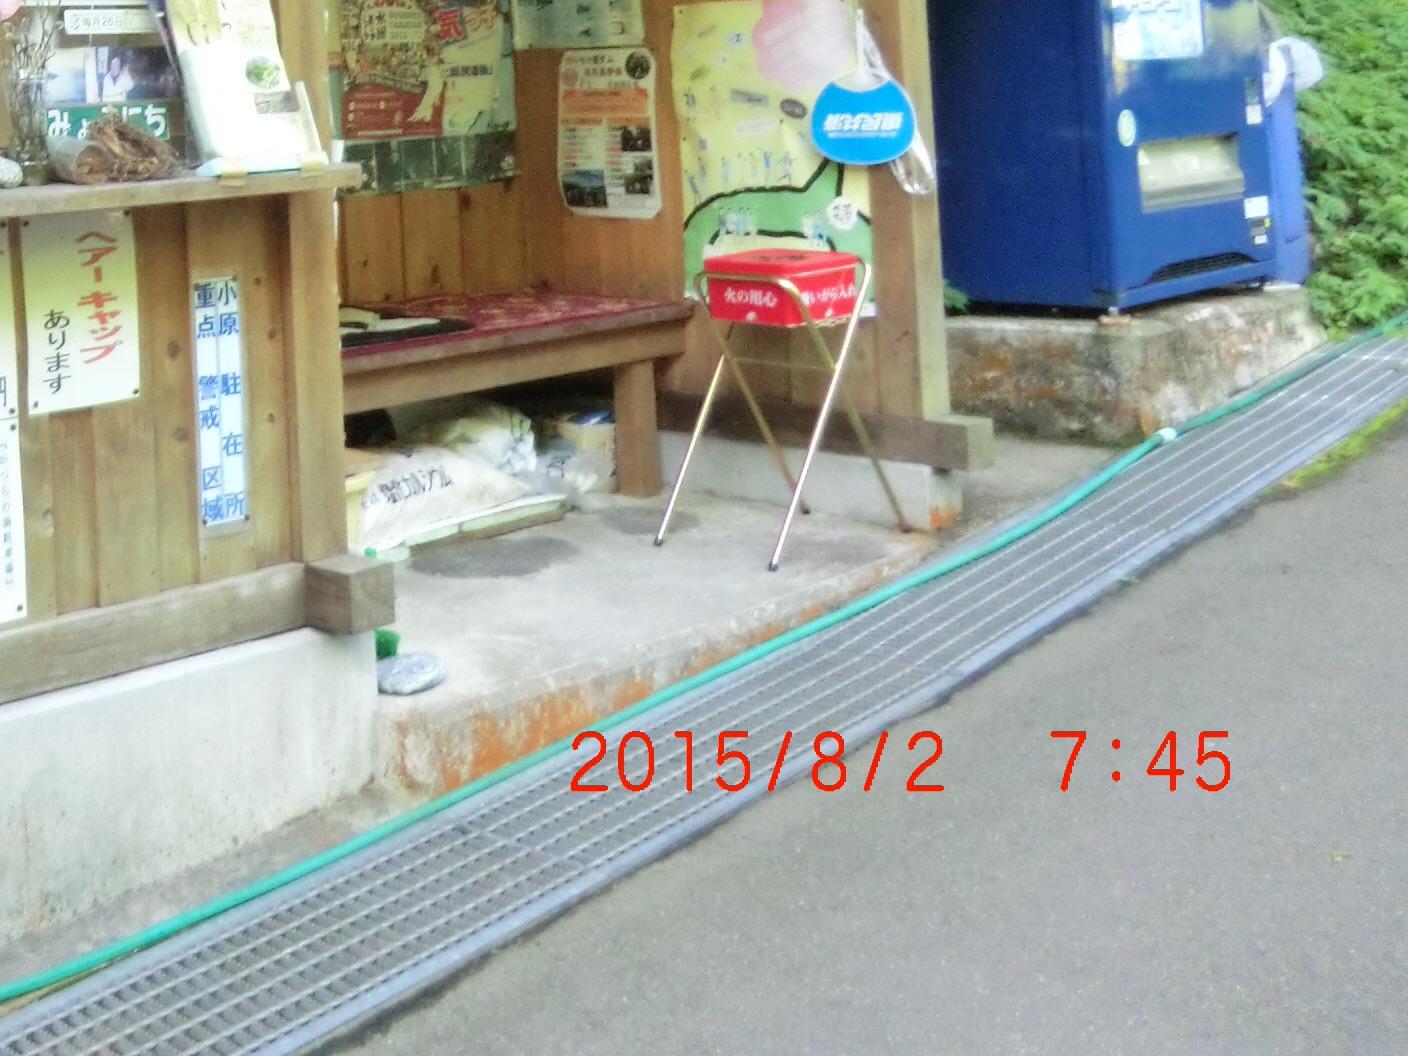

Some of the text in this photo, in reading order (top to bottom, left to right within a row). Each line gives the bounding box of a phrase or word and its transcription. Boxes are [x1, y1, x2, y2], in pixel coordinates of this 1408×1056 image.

[44, 308, 72, 396] あります
[75, 229, 124, 365] ヘアーキャップ
[194, 282, 225, 522] 重点警戒区域
[218, 279, 245, 518] 小原駐在所
